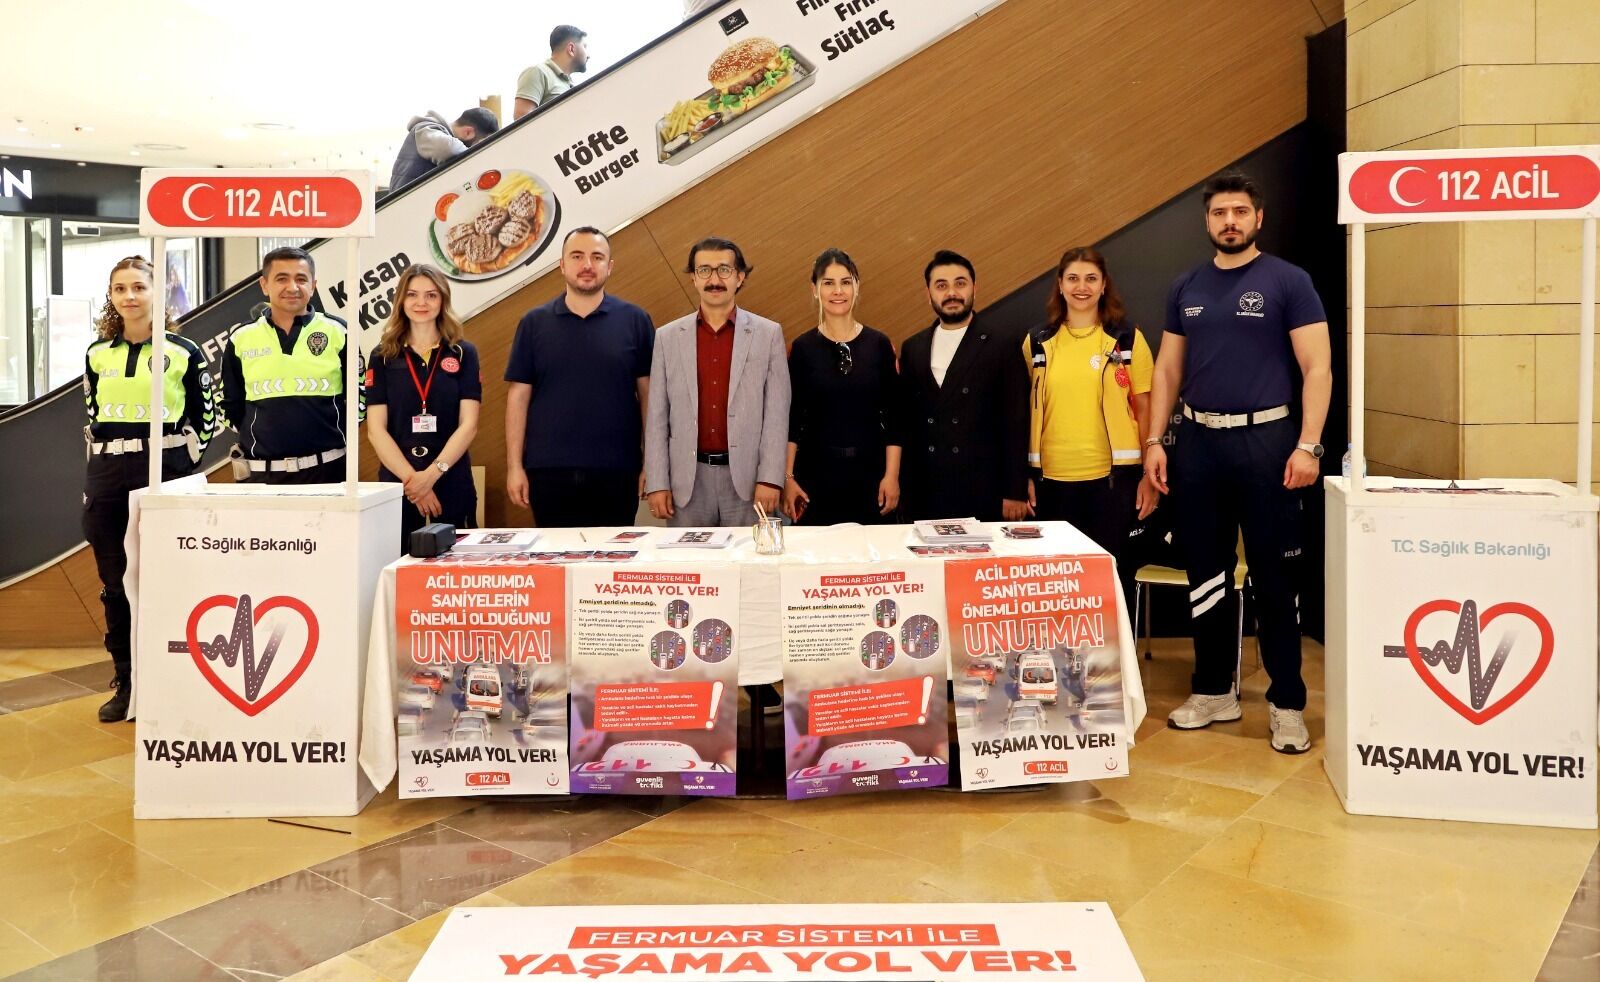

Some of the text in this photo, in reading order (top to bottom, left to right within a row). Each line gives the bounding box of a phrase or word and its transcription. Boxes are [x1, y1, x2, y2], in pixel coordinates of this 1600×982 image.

[820, 9, 895, 61] Sütlaç
[554, 125, 629, 177] Köfte
[574, 148, 640, 195] Burger
[1437, 164, 1560, 201] 112 ACİL
[224, 185, 327, 217] 112 ACİL
[177, 537, 317, 555] T.C. Sağlık Bakanlığı
[1391, 539, 1551, 560] T.C. Sağlık Bakanlığı
[425, 572, 536, 589] ACİL DURUMDA
[617, 573, 697, 582] FERMUAR SİSTEMİ İLE
[825, 573, 901, 584] FERMUAR SİSTEMİ İLE
[975, 560, 1084, 582] ACİL DURUMDA
[431, 590, 529, 608] SANİYELERİN
[594, 583, 719, 596] YAŞAMA YOL VER!
[802, 584, 924, 601] YAŞAMA YOL VER!
[982, 579, 1080, 600] SANİYELERİN
[410, 609, 551, 625] ÖNEMLİ OLDUĞUNU
[962, 595, 1102, 618] ÖNEMLİ OLDUĞUNU
[963, 613, 1105, 658] UNUTMA!
[410, 629, 552, 665] UNUTMA!
[143, 739, 346, 768] YAŞAMA YOL VER!
[971, 733, 1115, 758] YAŞAMA YOL VER!
[411, 746, 557, 768] YAŞAMA YOL VER!
[1036, 762, 1067, 772] 112 ACİL
[1357, 743, 1585, 779] YAŞAMA YOL VER!
[479, 774, 509, 783] 112 ACİL
[588, 927, 982, 945] FERMUAR SİSTEMİ İLE
[498, 950, 1077, 980] YAŞAMA YOL VER!
